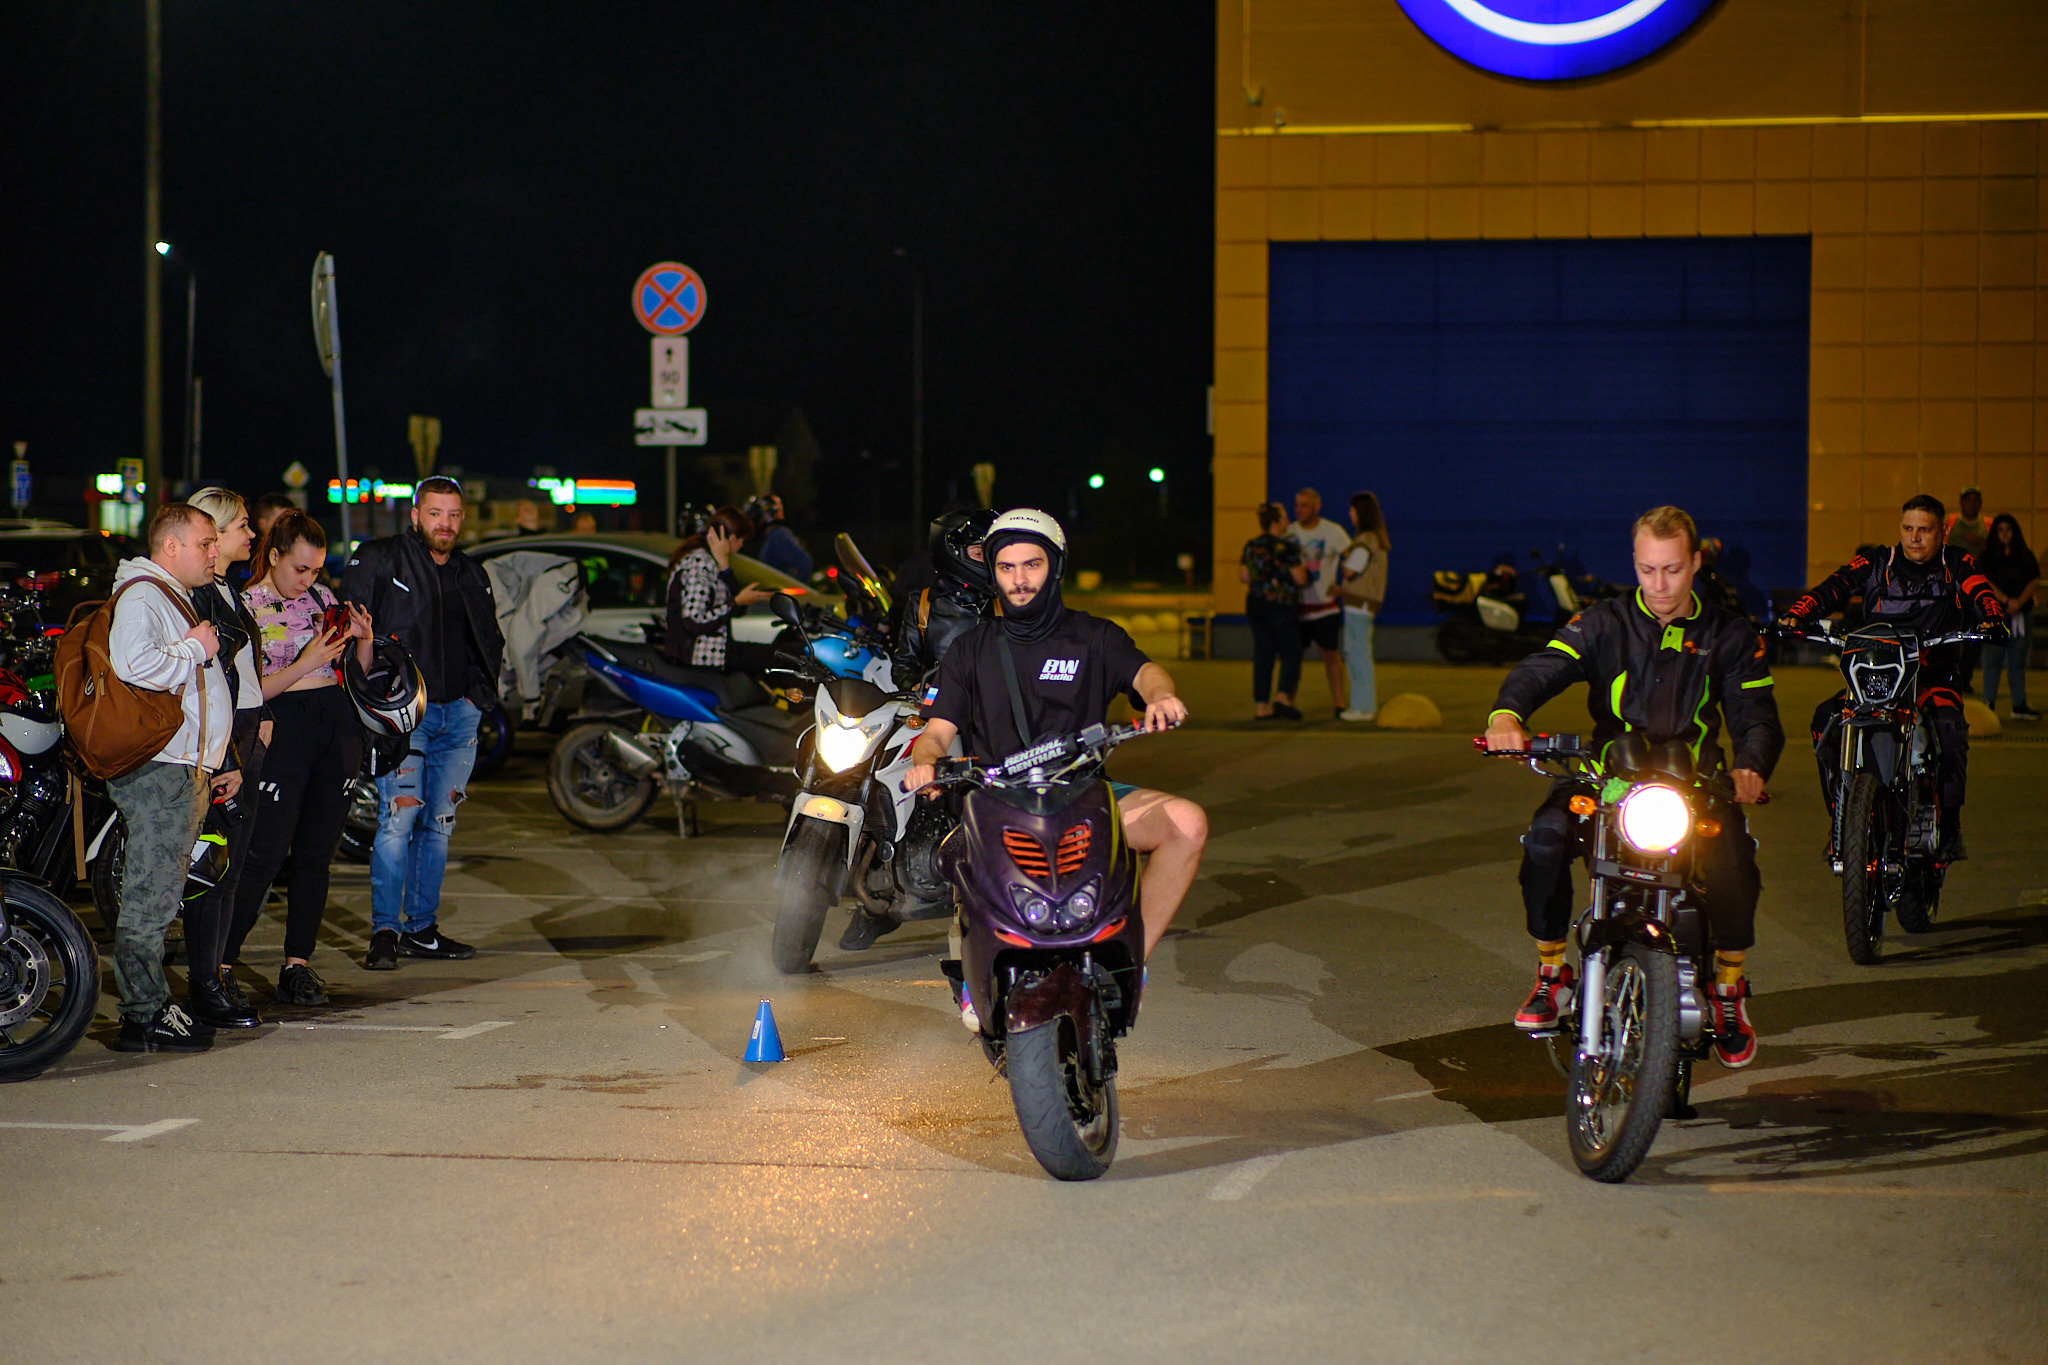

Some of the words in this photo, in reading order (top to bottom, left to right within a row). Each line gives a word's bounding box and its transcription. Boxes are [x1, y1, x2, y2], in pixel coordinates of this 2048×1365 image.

[1039, 672, 1074, 681] studio
[1041, 659, 1080, 674] BW
[1004, 739, 1064, 768] RENTHAL
[1008, 747, 1067, 776] RENTHAL
